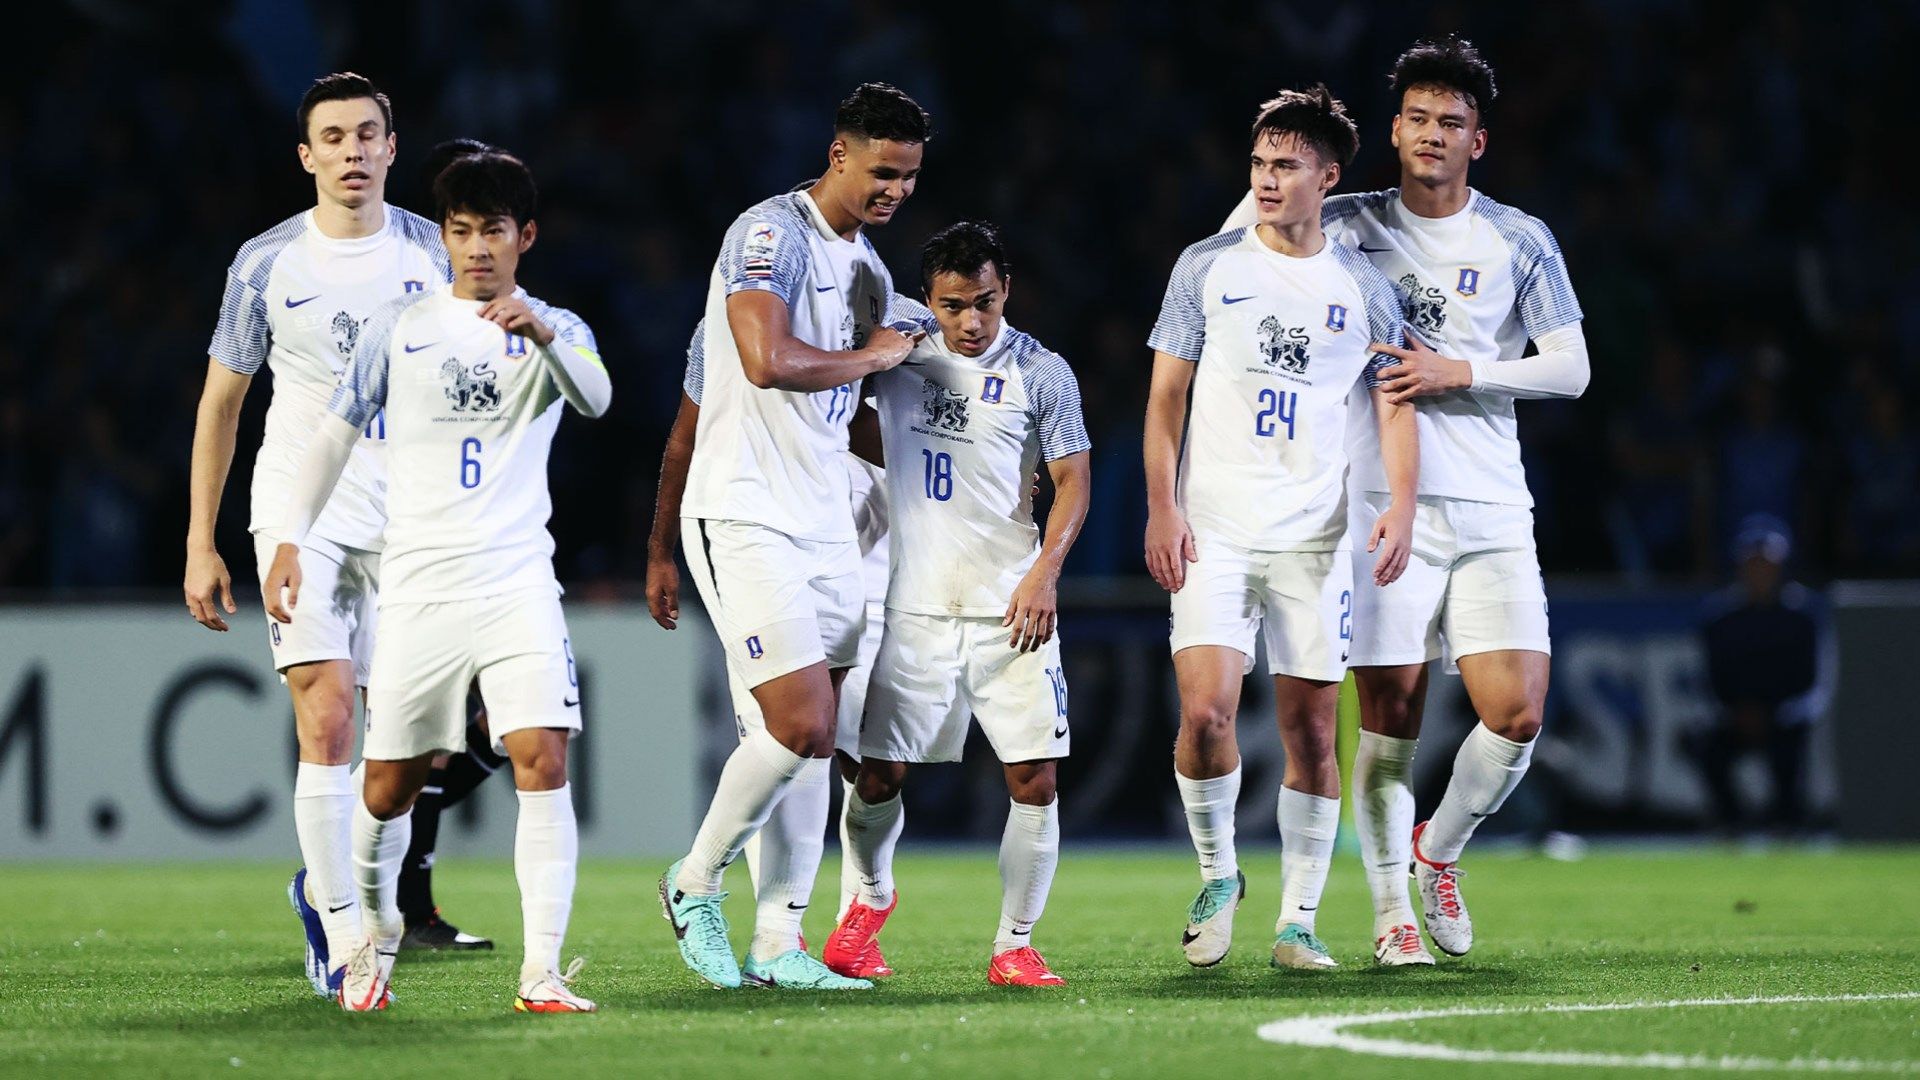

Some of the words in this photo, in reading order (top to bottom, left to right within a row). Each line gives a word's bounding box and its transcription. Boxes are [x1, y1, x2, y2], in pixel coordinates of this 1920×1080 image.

[910, 426, 930, 435] SINGHA
[930, 431, 974, 445] CORPORATION
[1256, 389, 1297, 440] 24
[460, 436, 481, 489] 6
[922, 448, 953, 502] 18
[1340, 590, 1353, 641] 2
[1045, 666, 1068, 717] 18
